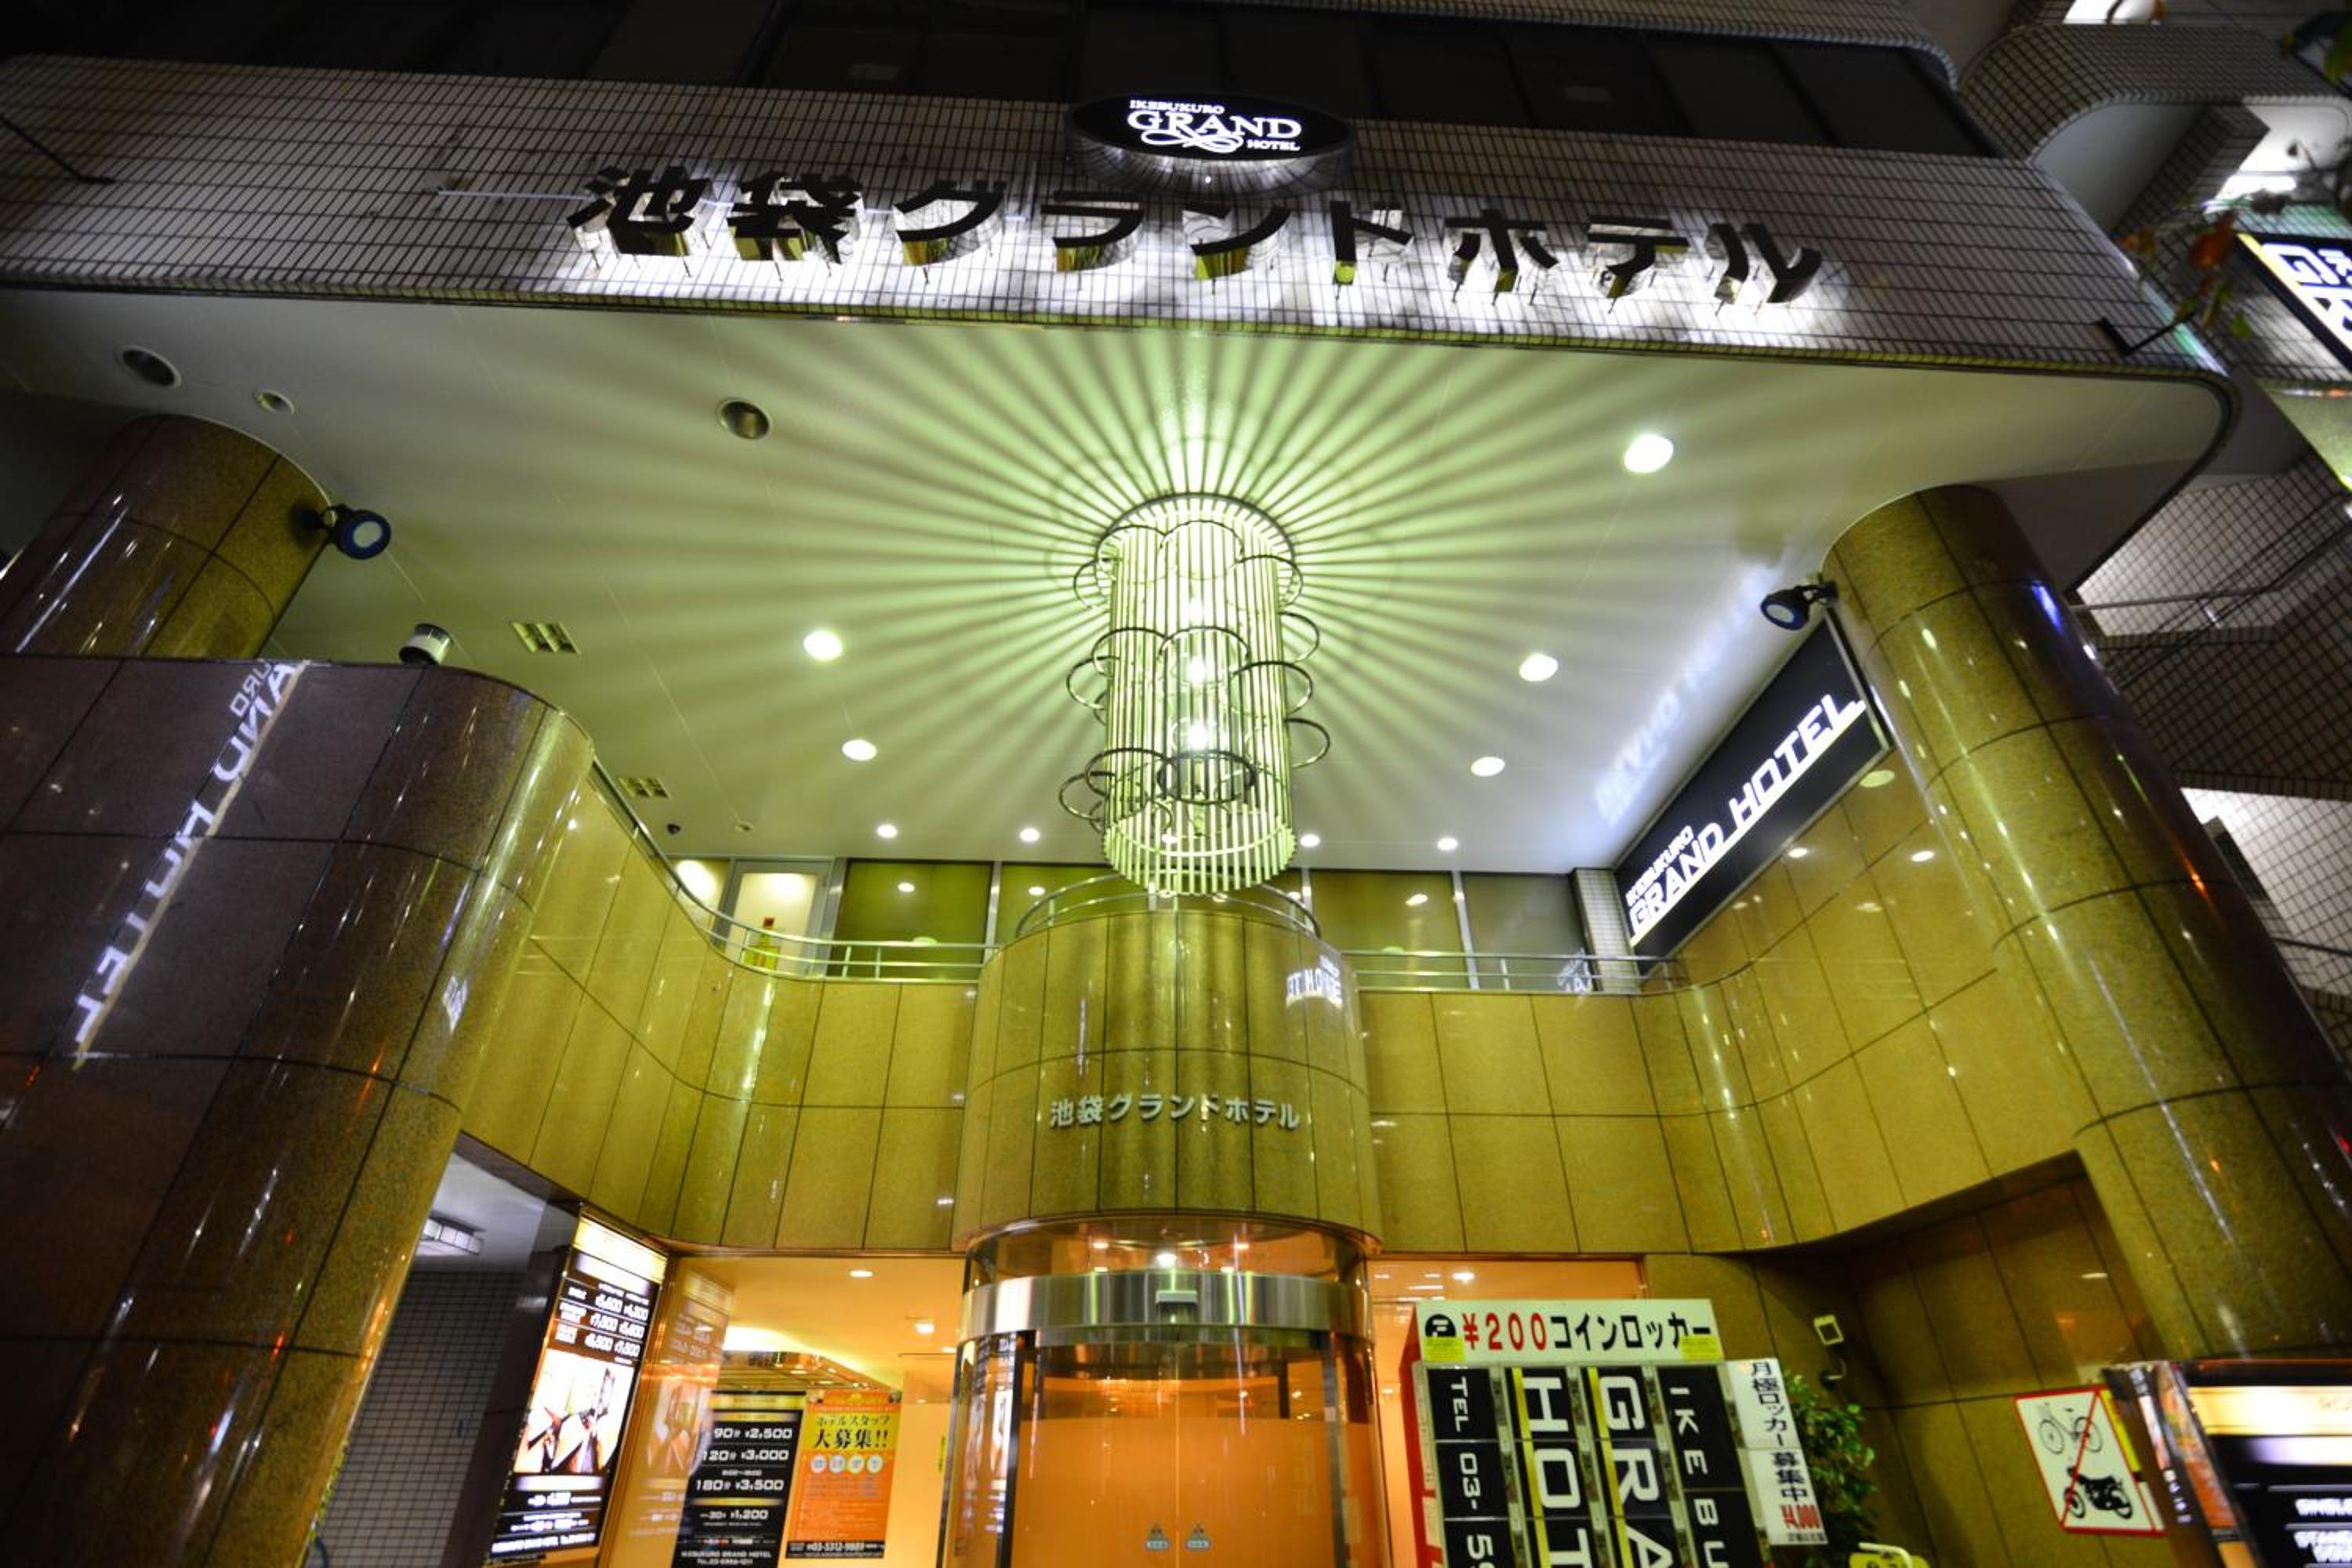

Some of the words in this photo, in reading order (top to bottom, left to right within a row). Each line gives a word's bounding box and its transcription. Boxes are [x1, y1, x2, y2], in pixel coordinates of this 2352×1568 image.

[1130, 100, 1225, 114] IKEBUKURO
[1127, 110, 1301, 143] GRAND
[1247, 140, 1301, 151] HOTEL
[566, 165, 1823, 304] 池袋グランドホテル
[1629, 822, 1725, 938] GRAND
[1729, 694, 1862, 831] HOTEL
[1050, 1094, 1299, 1130] 池袋グランドホテル
[1451, 1376, 1469, 1432] TEL
